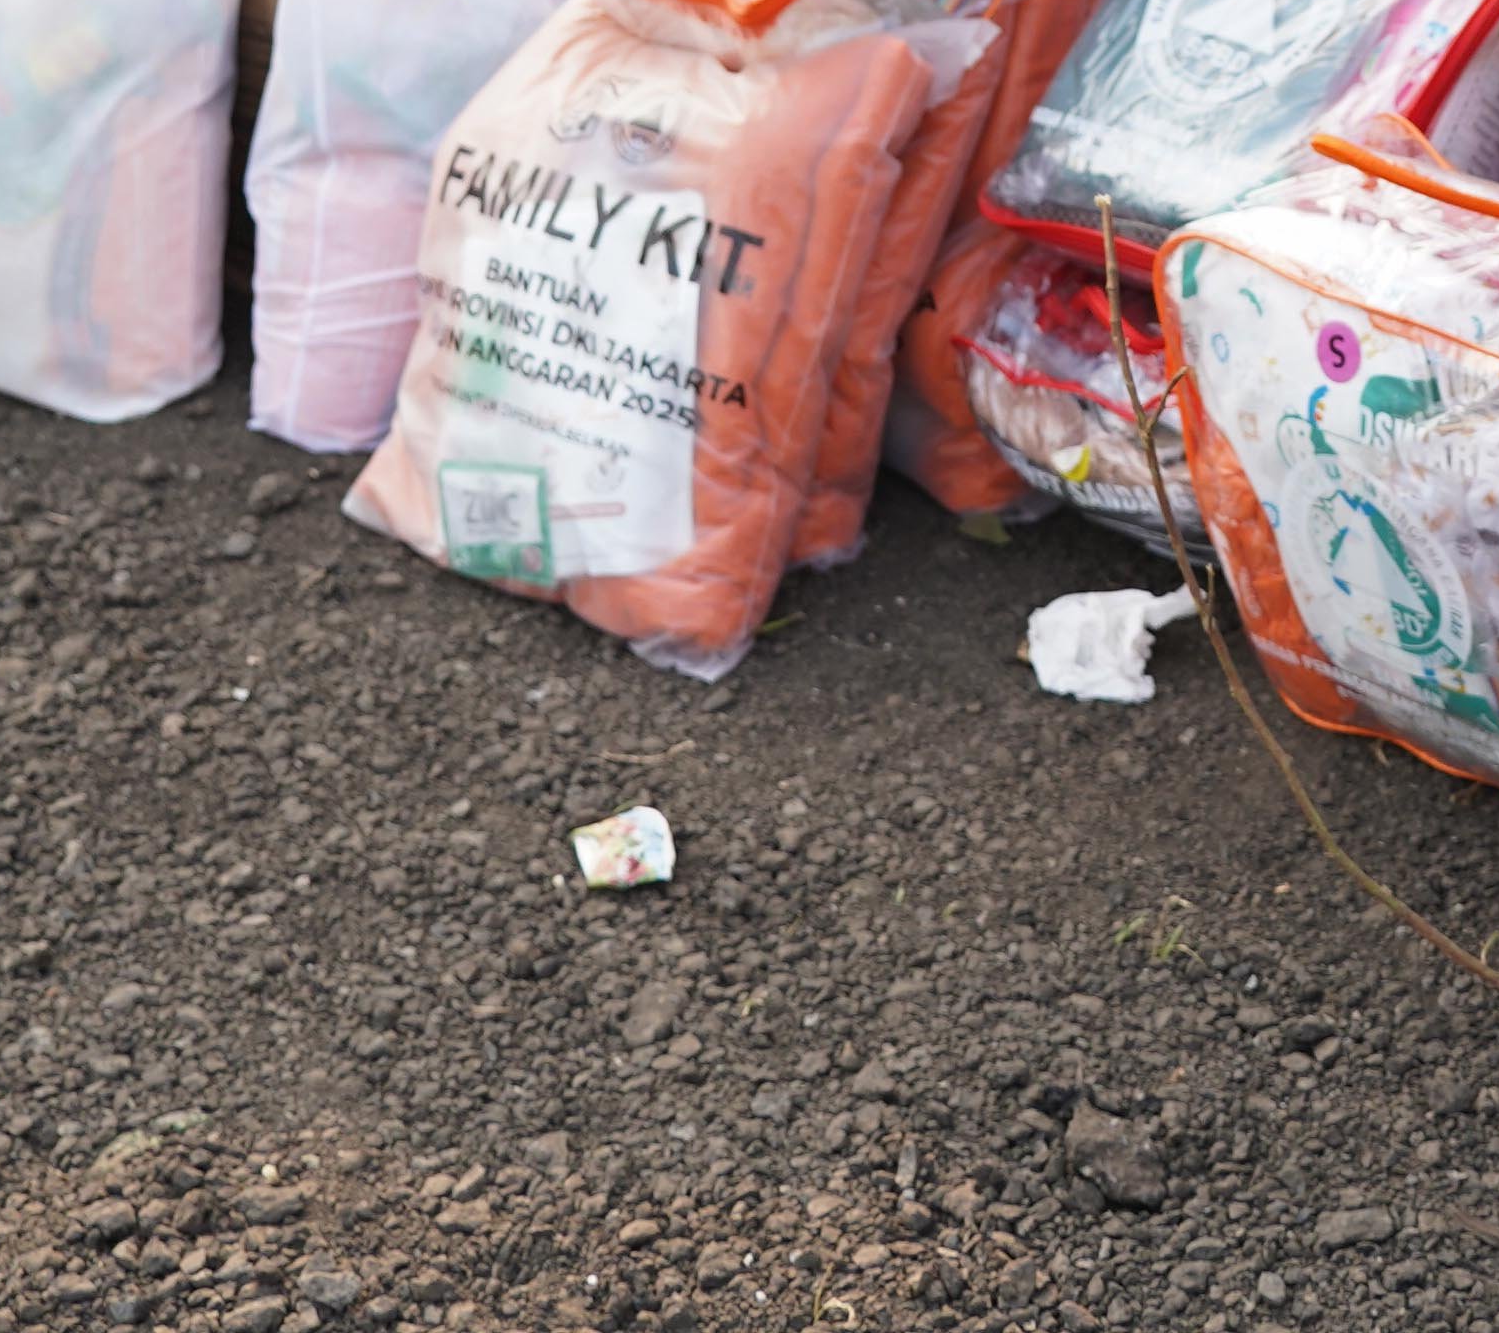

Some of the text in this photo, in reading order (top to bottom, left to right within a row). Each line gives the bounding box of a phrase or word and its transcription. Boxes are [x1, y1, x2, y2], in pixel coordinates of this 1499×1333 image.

[439, 145, 765, 294] FAMILY KIT
[485, 257, 609, 316] BANTUAN
[465, 336, 614, 401] ANGGARAN
[622, 385, 698, 429] 2025
[605, 337, 748, 408] JAKARTA
[1329, 334, 1346, 369] S
